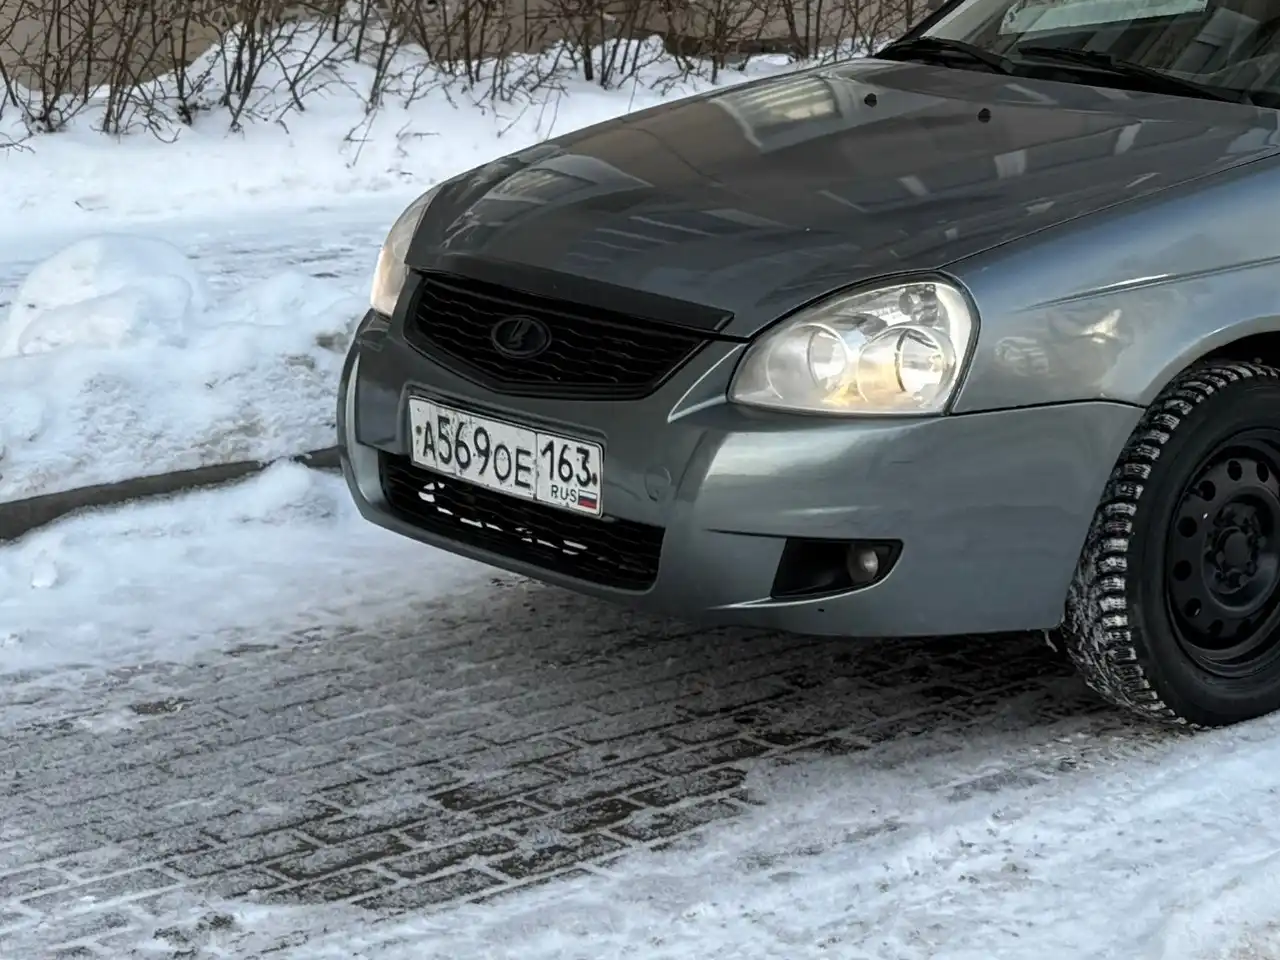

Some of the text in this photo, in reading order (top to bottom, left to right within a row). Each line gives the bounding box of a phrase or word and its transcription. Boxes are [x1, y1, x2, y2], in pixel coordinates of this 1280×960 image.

[423, 415, 592, 488] А569ОЕ 163
[551, 485, 578, 503] RUS
